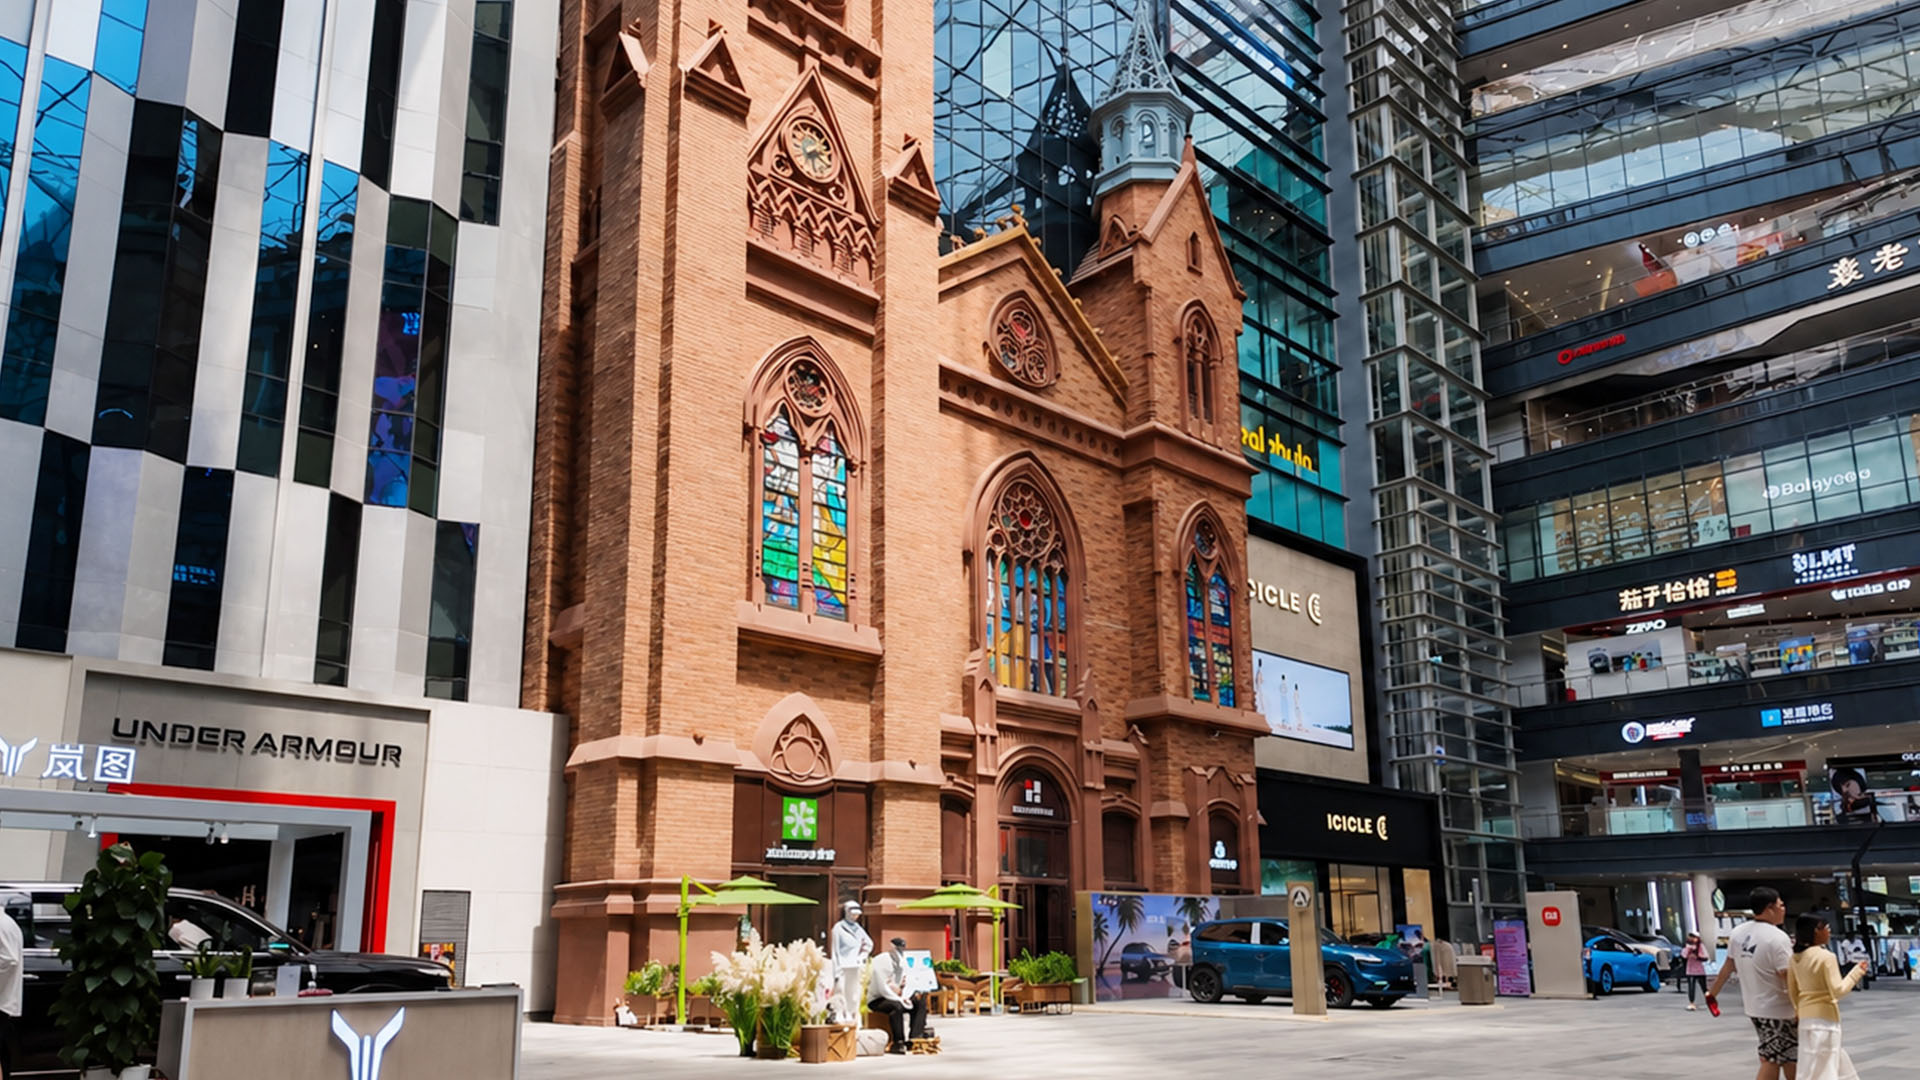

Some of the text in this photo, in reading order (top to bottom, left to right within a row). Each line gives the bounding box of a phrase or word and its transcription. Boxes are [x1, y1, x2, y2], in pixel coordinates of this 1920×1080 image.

[111, 717, 403, 765] UNDER ARMOUR
[42, 744, 136, 784] 岚图
[1327, 813, 1373, 834] ICICLE
